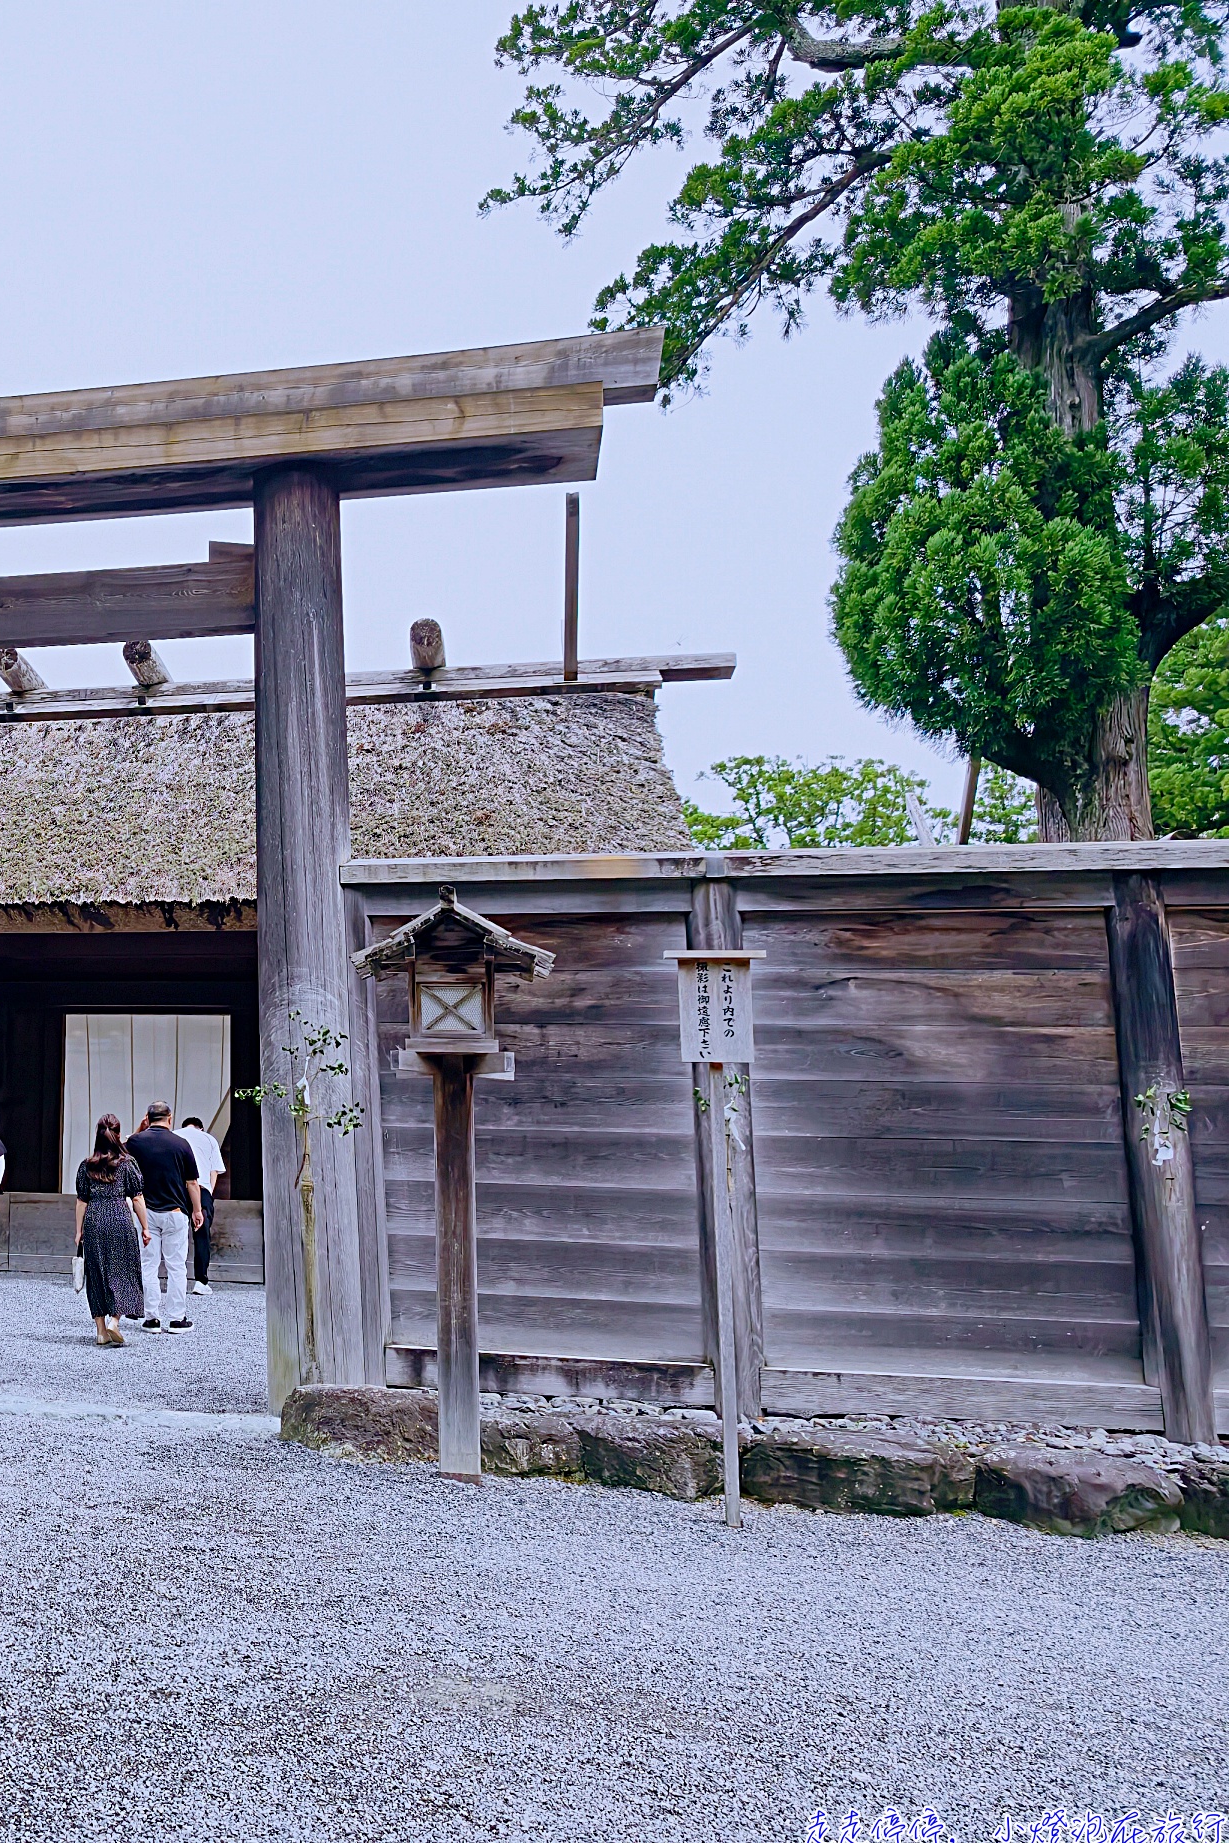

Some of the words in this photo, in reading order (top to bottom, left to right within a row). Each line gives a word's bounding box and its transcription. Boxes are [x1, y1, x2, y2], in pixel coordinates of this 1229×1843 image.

[722, 962, 734, 1038] これより内での
